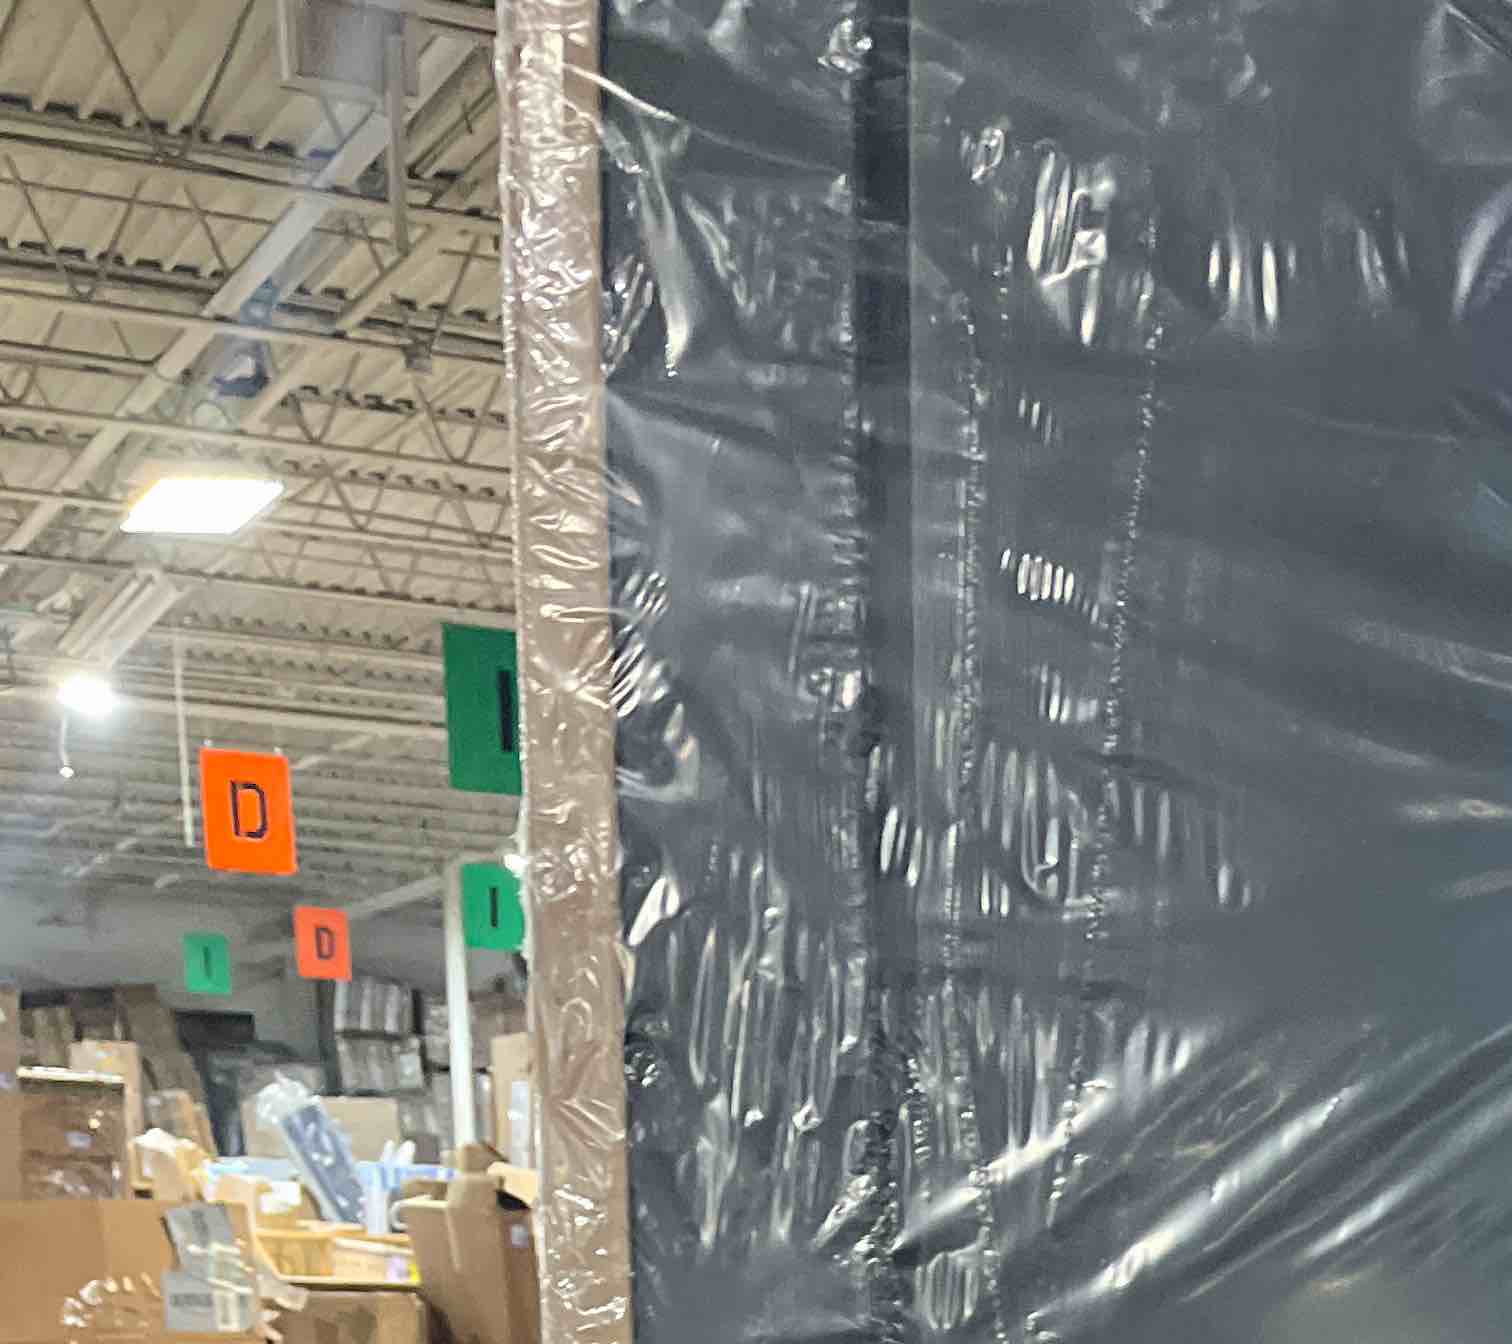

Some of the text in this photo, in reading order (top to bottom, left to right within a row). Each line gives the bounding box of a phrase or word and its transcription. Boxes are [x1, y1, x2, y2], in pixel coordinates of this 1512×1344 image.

[229, 780, 267, 840] D
[489, 887, 499, 928] I
[315, 925, 335, 960] D
